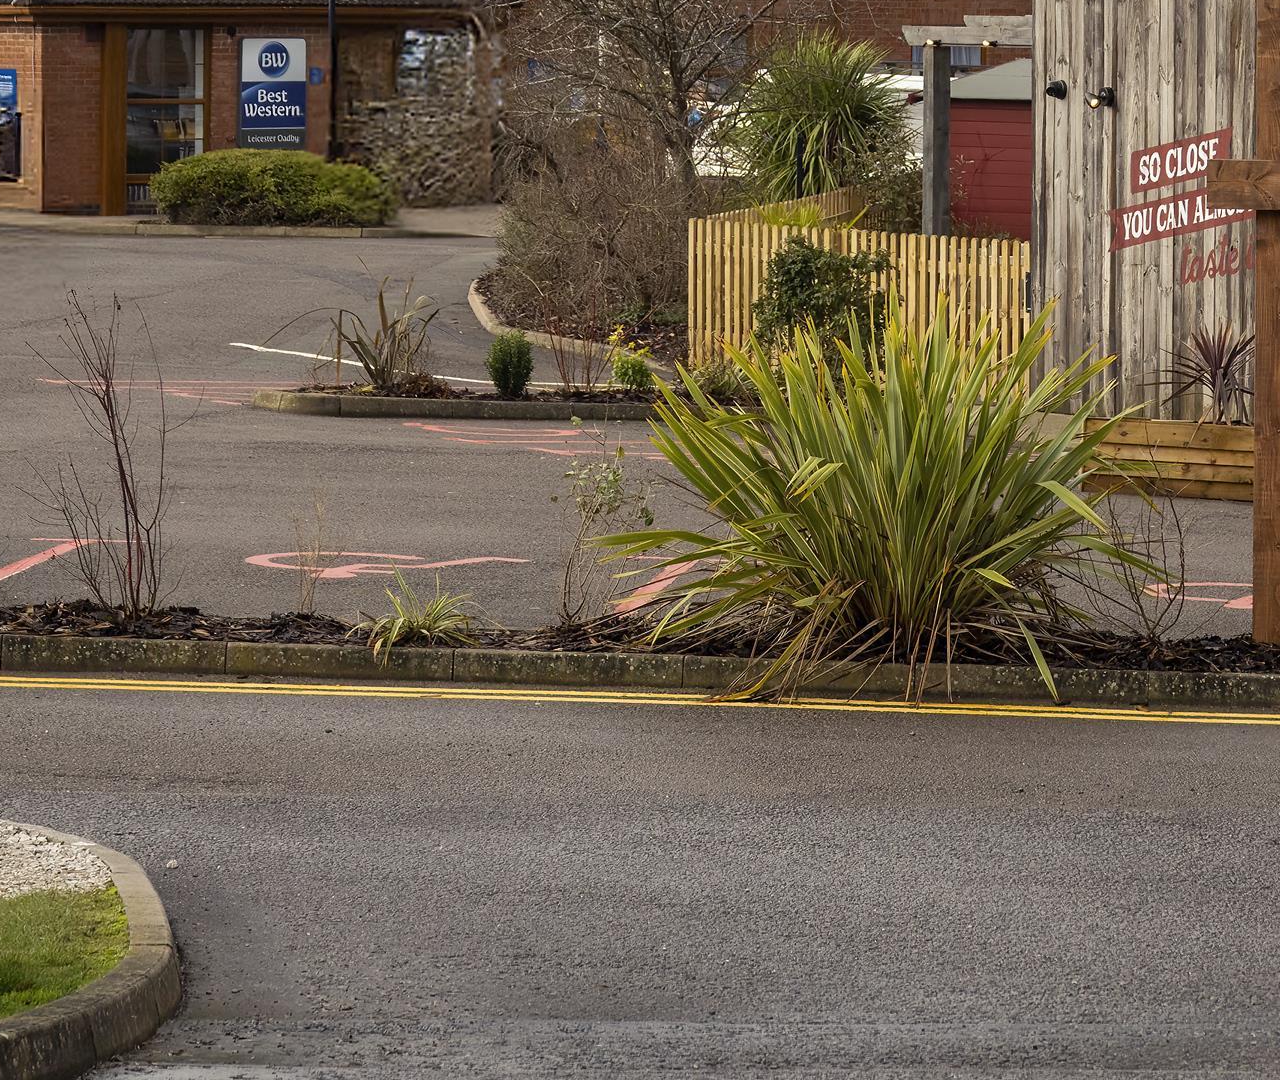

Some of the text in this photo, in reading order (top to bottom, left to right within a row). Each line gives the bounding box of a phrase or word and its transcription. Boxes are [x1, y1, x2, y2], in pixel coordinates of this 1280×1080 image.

[261, 52, 287, 68] BW
[257, 89, 288, 103] Best
[247, 134, 300, 144] Leicester Oadby
[1138, 151, 1162, 186] SO
[1122, 207, 1154, 241] YOU
[1156, 199, 1189, 233] CAN
[1181, 233, 1240, 284] taste
